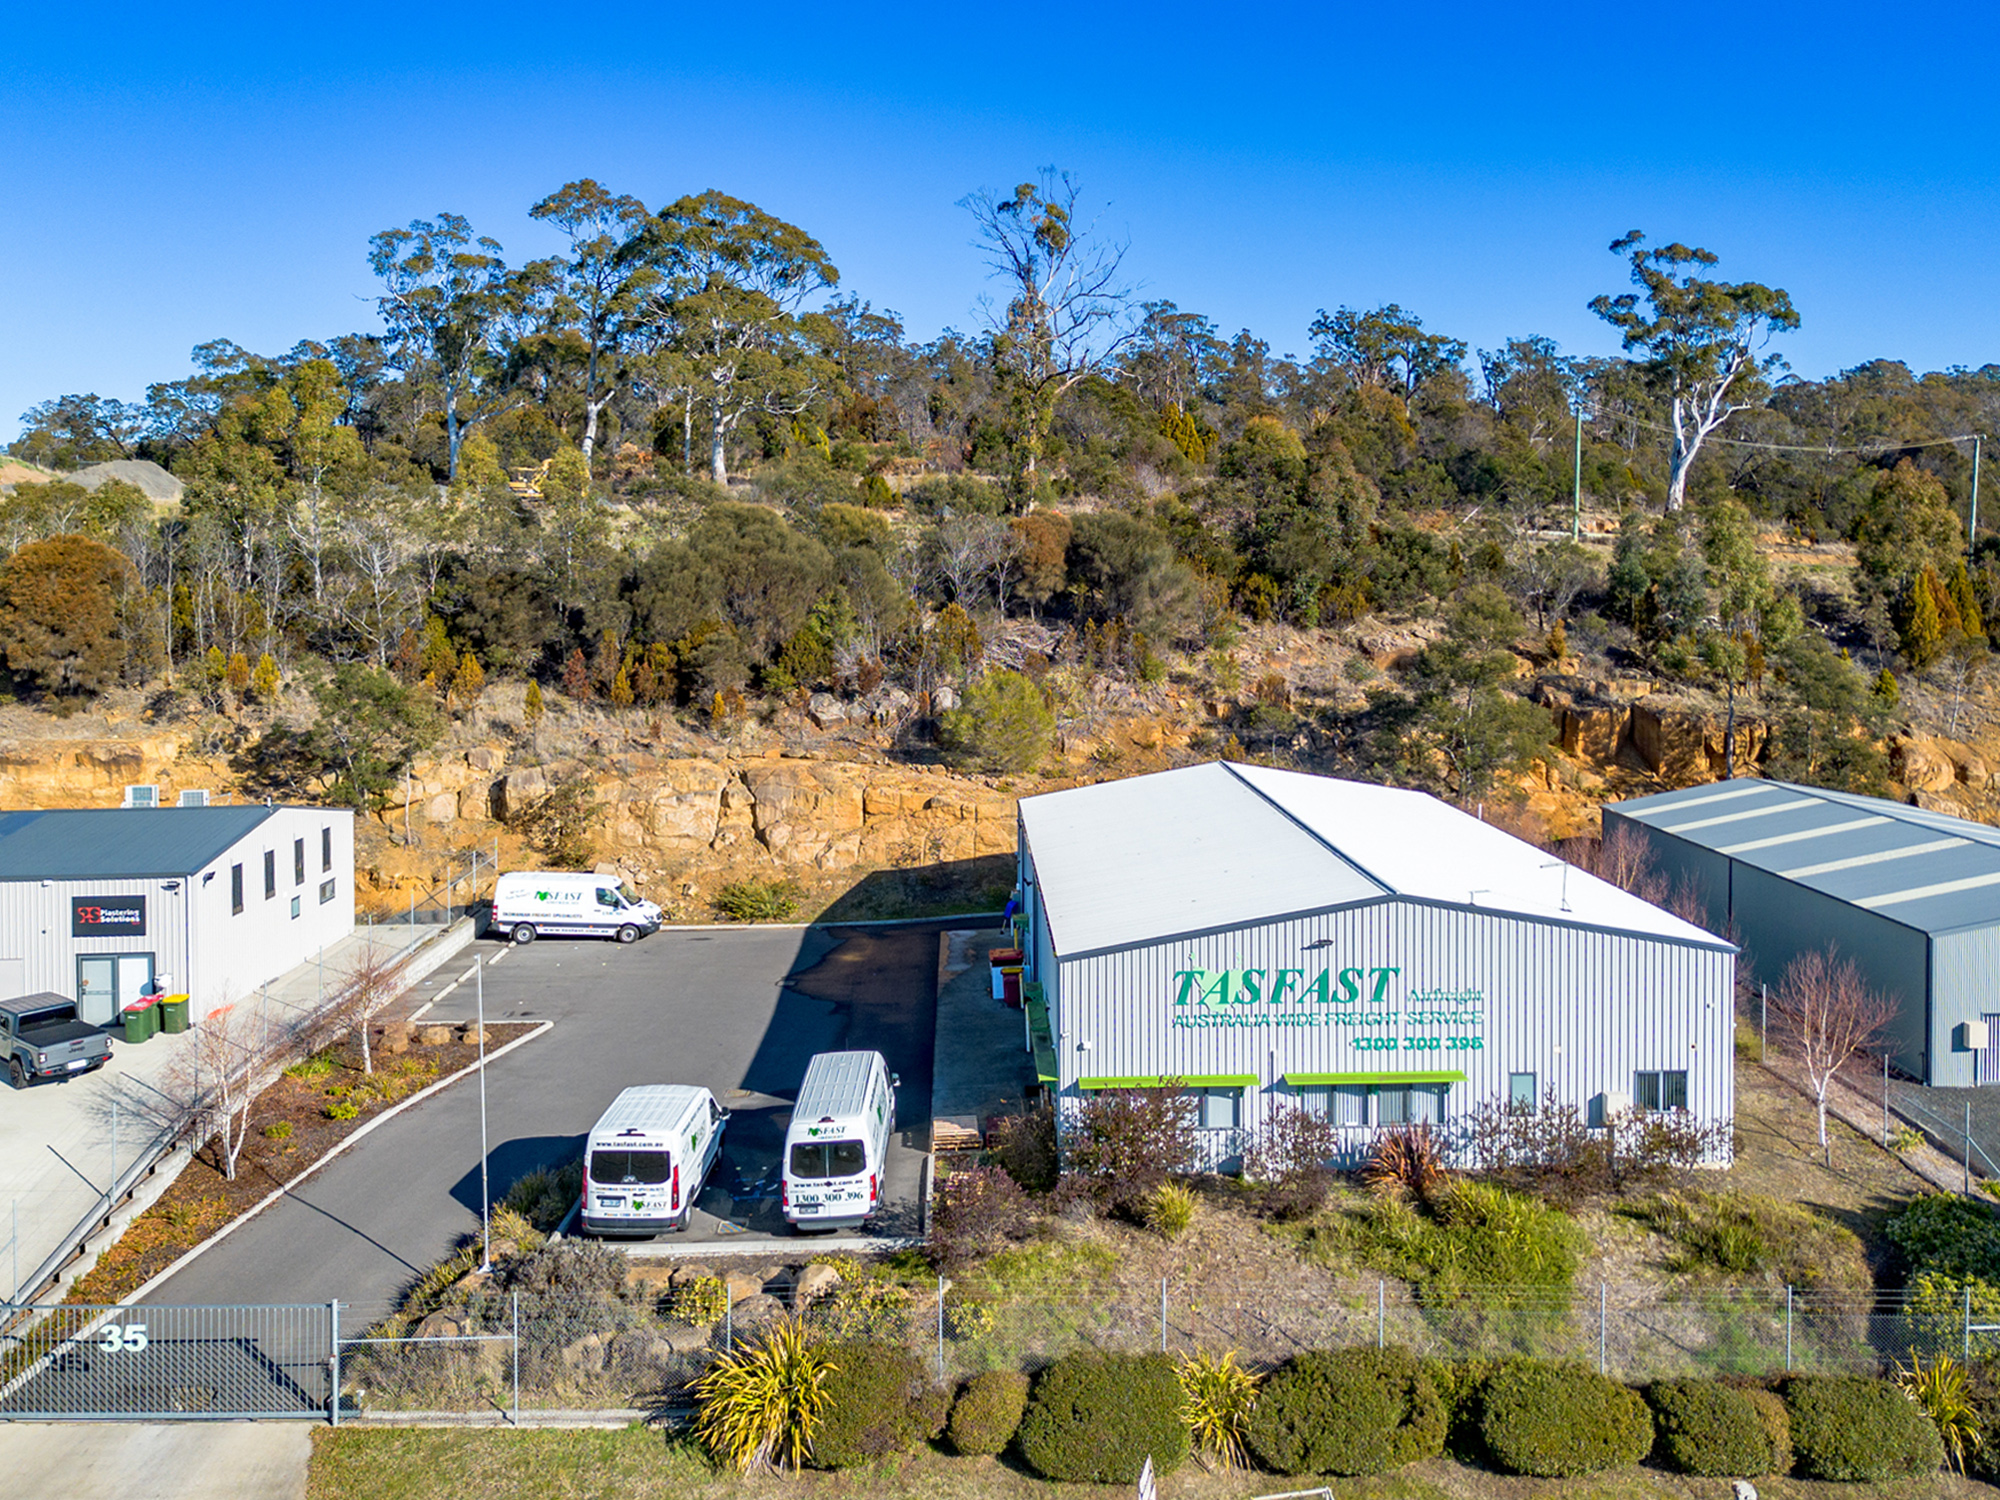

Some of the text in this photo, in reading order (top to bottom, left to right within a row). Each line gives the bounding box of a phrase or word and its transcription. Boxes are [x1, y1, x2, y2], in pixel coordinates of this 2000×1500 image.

[534, 890, 583, 901] TSFAST
[101, 909, 140, 917] Plastering
[1172, 967, 1401, 1006] TASFAST
[1407, 987, 1484, 1006] Airfreight
[1172, 1010, 1484, 1028] AUSTRALIA WIDE FREIGHT SERVICE
[1352, 1036, 1484, 1051] 1300 300 396
[807, 1126, 847, 1137] TSFAST
[794, 1180, 863, 1188] www.tast.com.au
[795, 1191, 863, 1204] 1300 300 396
[632, 1201, 667, 1209] TSFAST
[100, 1324, 148, 1352] 35
